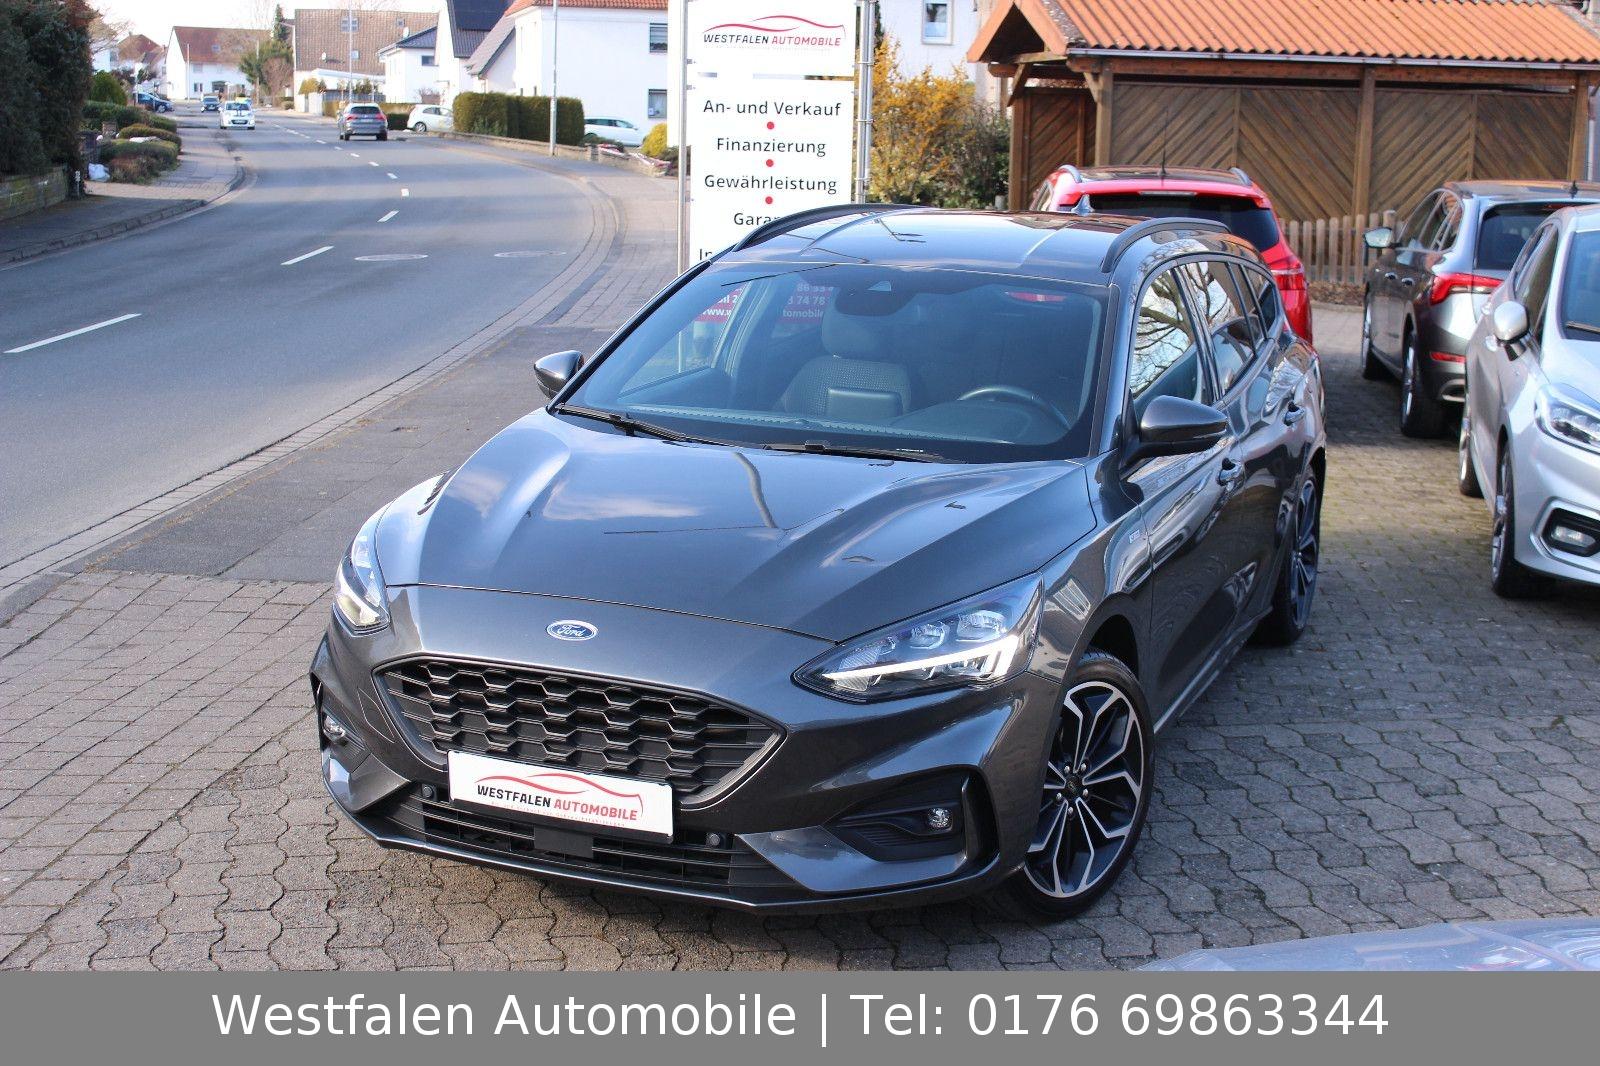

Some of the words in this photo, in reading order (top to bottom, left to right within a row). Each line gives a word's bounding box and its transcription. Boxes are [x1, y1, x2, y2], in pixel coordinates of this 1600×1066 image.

[703, 34, 769, 44] WESTFALEN
[771, 36, 841, 46] AUTOMOBILE
[703, 100, 731, 113] An-
[736, 101, 768, 114] und
[774, 102, 842, 116] Verkauf
[716, 138, 826, 157] Finanzierung
[704, 174, 837, 194] Gewährleistung
[477, 785, 551, 808] WESTFALEN
[553, 798, 638, 821] AUTOMOBILE
